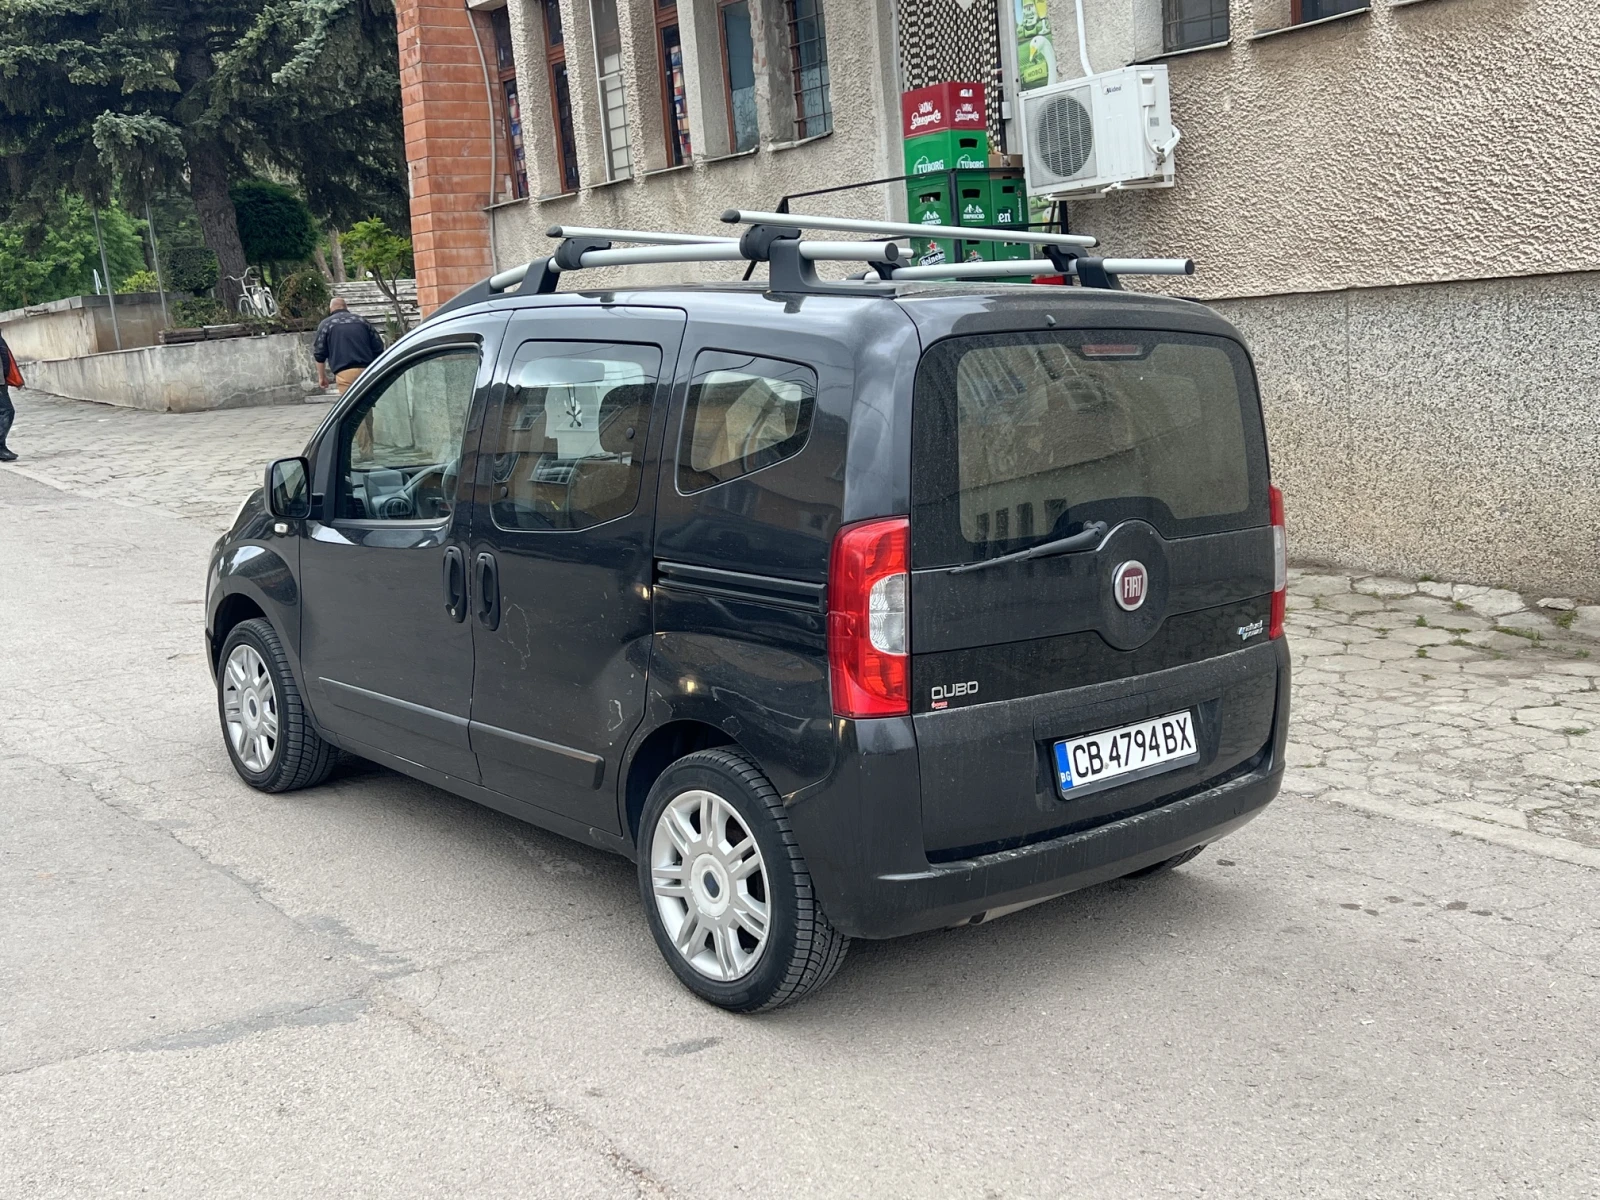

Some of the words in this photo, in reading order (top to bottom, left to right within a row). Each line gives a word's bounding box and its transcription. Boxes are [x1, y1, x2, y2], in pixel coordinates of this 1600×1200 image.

[918, 160, 944, 174] TUBORG
[960, 160, 984, 169] TUBORG
[1124, 575, 1142, 598] FIAT
[931, 681, 979, 699] QUBO
[1061, 771, 1071, 783] BG
